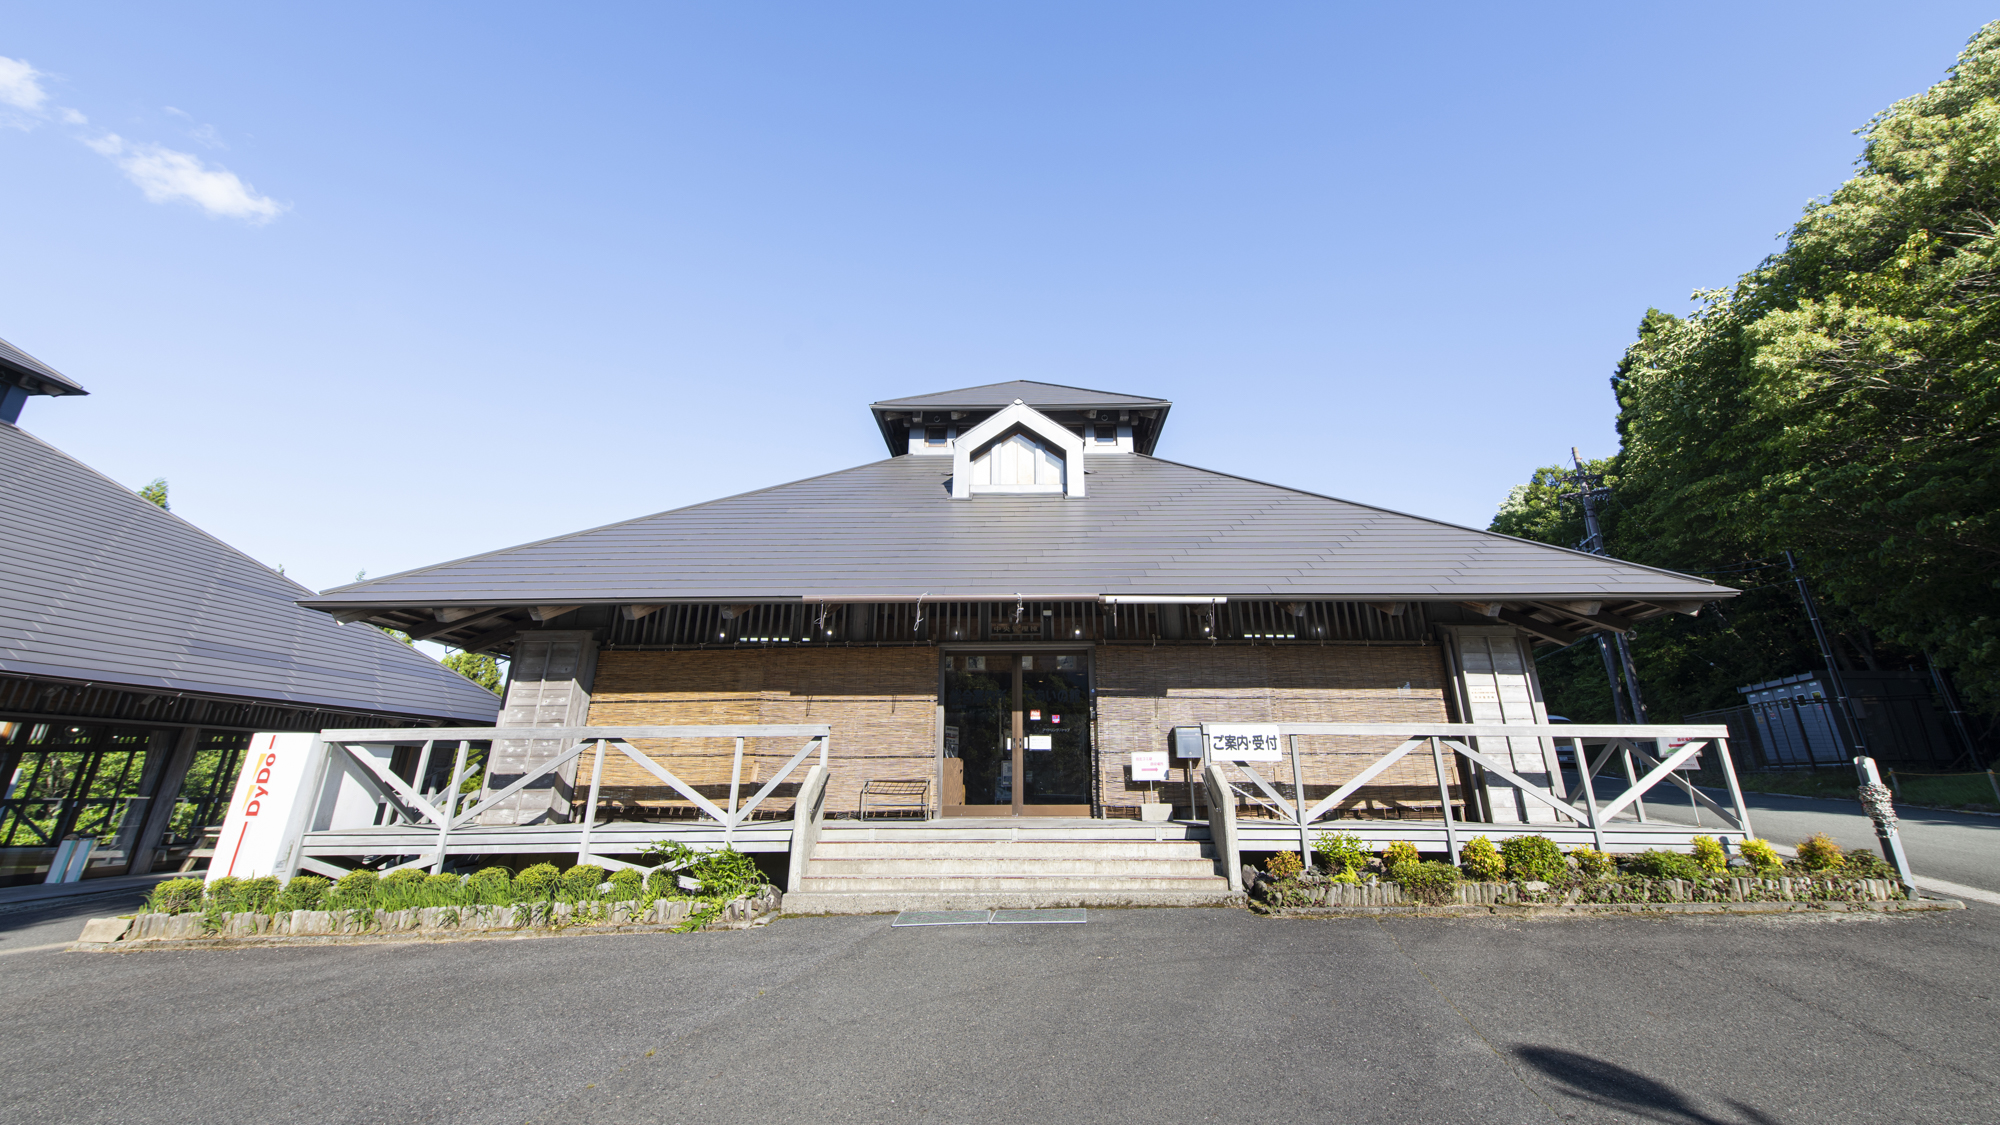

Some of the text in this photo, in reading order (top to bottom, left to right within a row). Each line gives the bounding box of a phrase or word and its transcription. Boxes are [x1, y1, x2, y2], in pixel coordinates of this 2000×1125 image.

[1023, 688, 1081, 703] であいの館
[1213, 734, 1278, 751] ご案内・受付
[245, 753, 276, 816] DyDo
